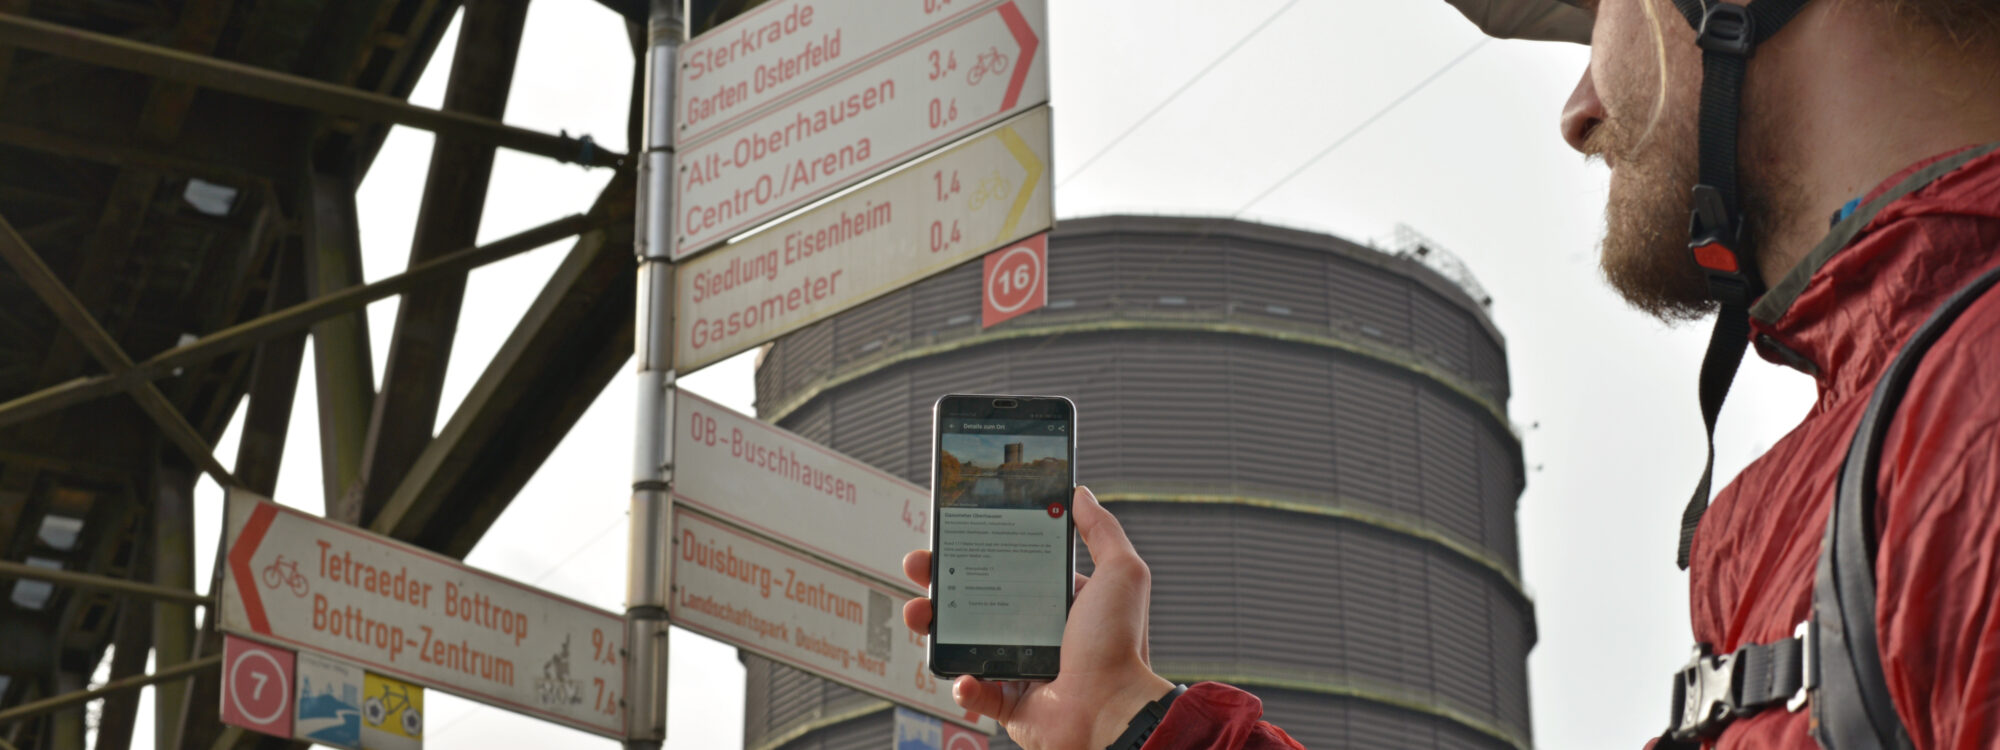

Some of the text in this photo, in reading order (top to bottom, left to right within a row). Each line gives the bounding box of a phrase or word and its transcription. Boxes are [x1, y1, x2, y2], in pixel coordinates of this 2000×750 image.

[687, 27, 841, 125] Garten Osterfeld
[689, 4, 814, 81] Sterkrade
[928, 50, 957, 81] 3,4
[686, 78, 895, 192] Alt-Oberhausen
[929, 98, 957, 129] 0,6
[934, 169, 961, 202] 1,4
[693, 201, 892, 304] Siedlung Eisenheim
[930, 220, 961, 253] 0,4
[691, 269, 842, 349] Gasometer
[998, 265, 1030, 296] 16
[690, 411, 857, 505] OB-Buschhausen
[901, 500, 927, 534] 4,2
[316, 539, 528, 643] Tetraeder Bottrop
[681, 529, 864, 625] Duisburg-Zentrum
[313, 593, 515, 686] Bottrop-Zentrum
[592, 627, 617, 665] 9,4
[680, 585, 887, 677] Landschaftspark Duisburg-Nord
[250, 671, 269, 700] 7
[594, 676, 617, 716] 7,6
